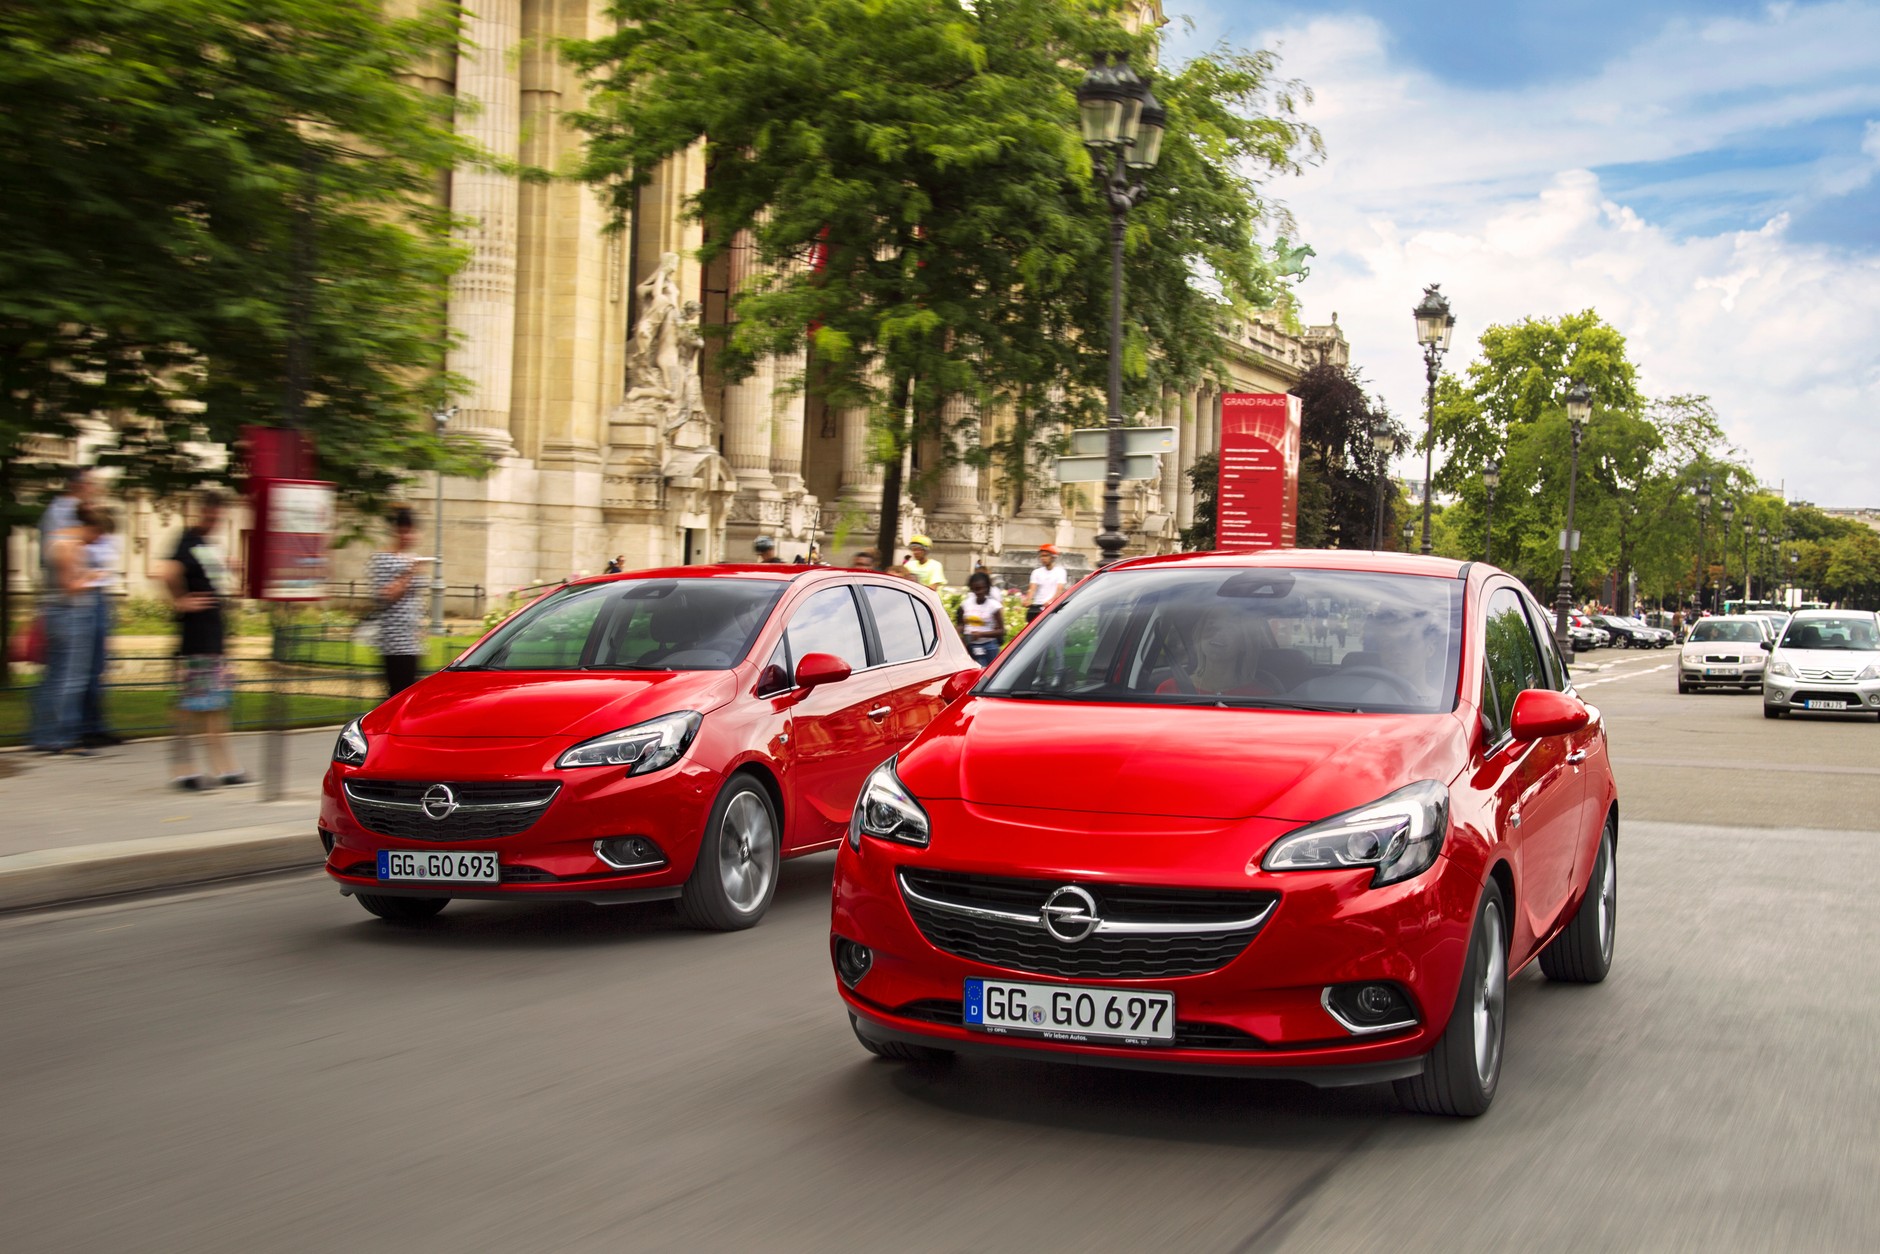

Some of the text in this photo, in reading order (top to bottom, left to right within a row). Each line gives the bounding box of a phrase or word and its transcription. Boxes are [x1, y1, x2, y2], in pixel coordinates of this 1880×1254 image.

[1223, 397, 1285, 407] GRAND PALAIS
[390, 854, 494, 878] GG GO 693
[970, 1005, 978, 1016] D
[986, 986, 1168, 1032] GG GO 697
[1054, 1032, 1069, 1040] leben
